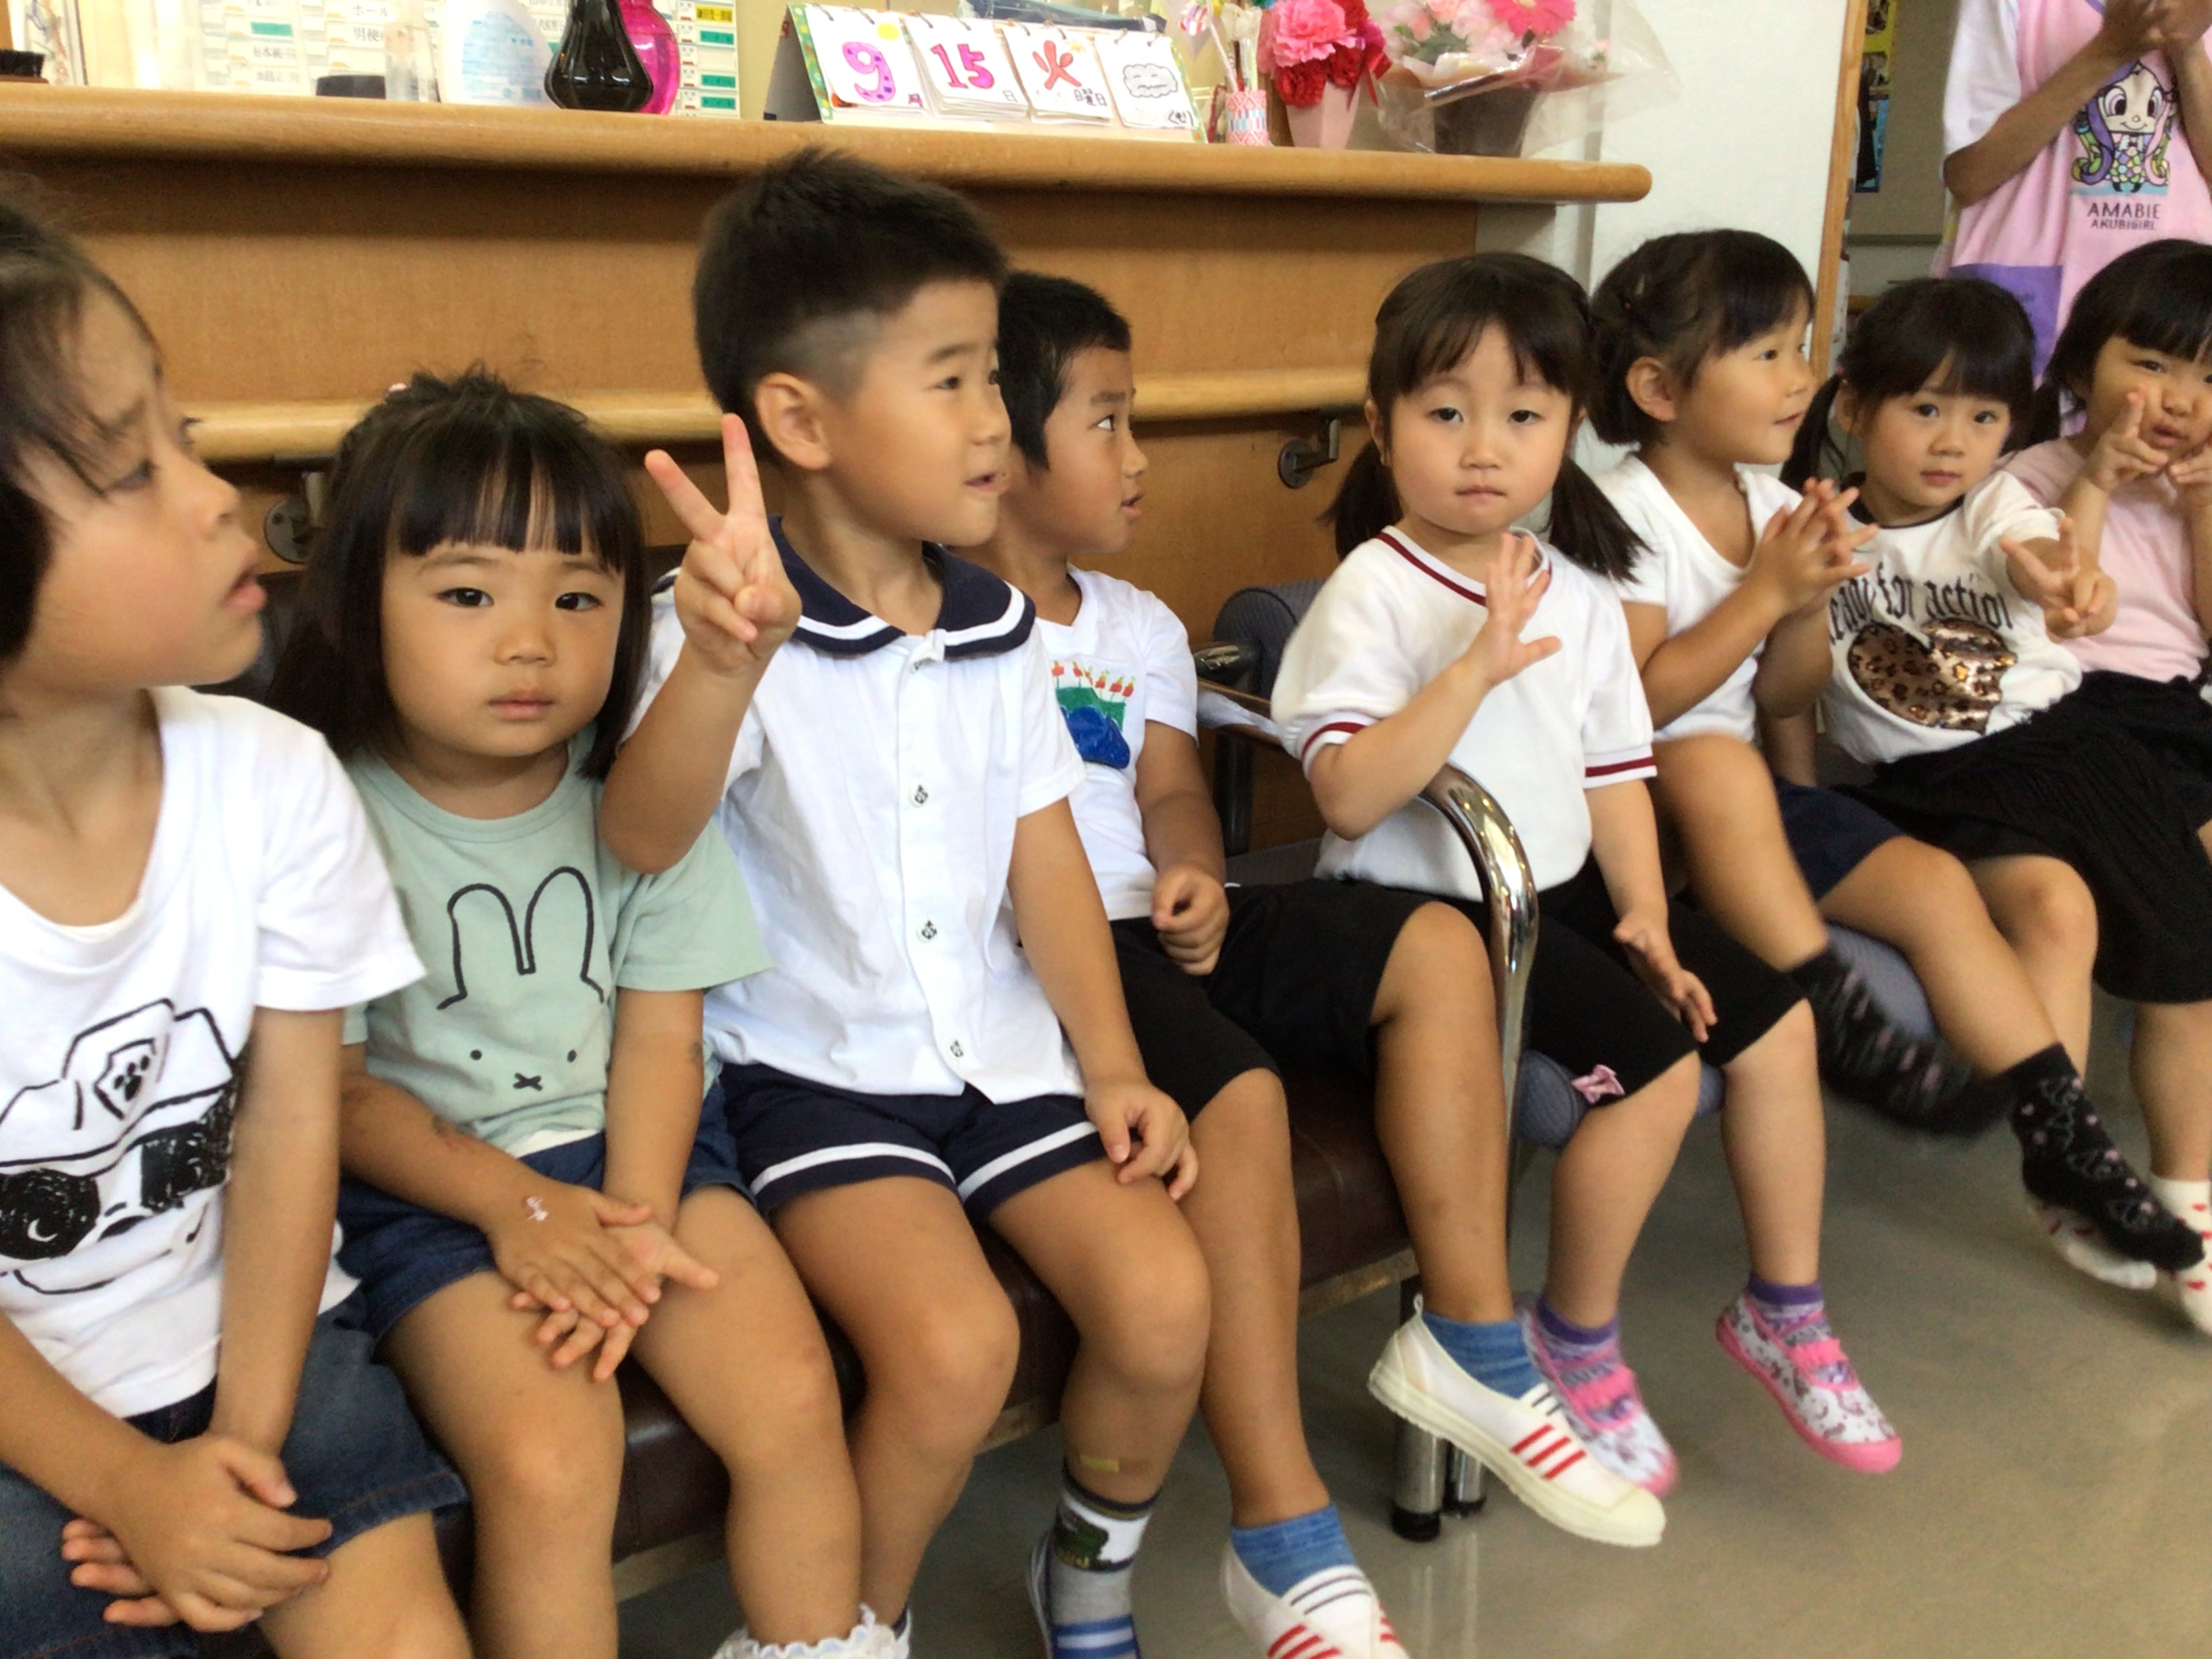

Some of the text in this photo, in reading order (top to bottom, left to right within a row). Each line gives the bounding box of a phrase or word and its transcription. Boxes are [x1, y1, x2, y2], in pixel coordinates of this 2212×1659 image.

[842, 41, 897, 102] 9
[930, 43, 995, 89] 15
[1031, 40, 1082, 90] 火
[907, 93, 924, 108] 月
[1002, 89, 1018, 103] 日
[1073, 88, 1108, 107] 曜日
[2087, 202, 2161, 219] AMABIE
[1875, 561, 1915, 621] for
